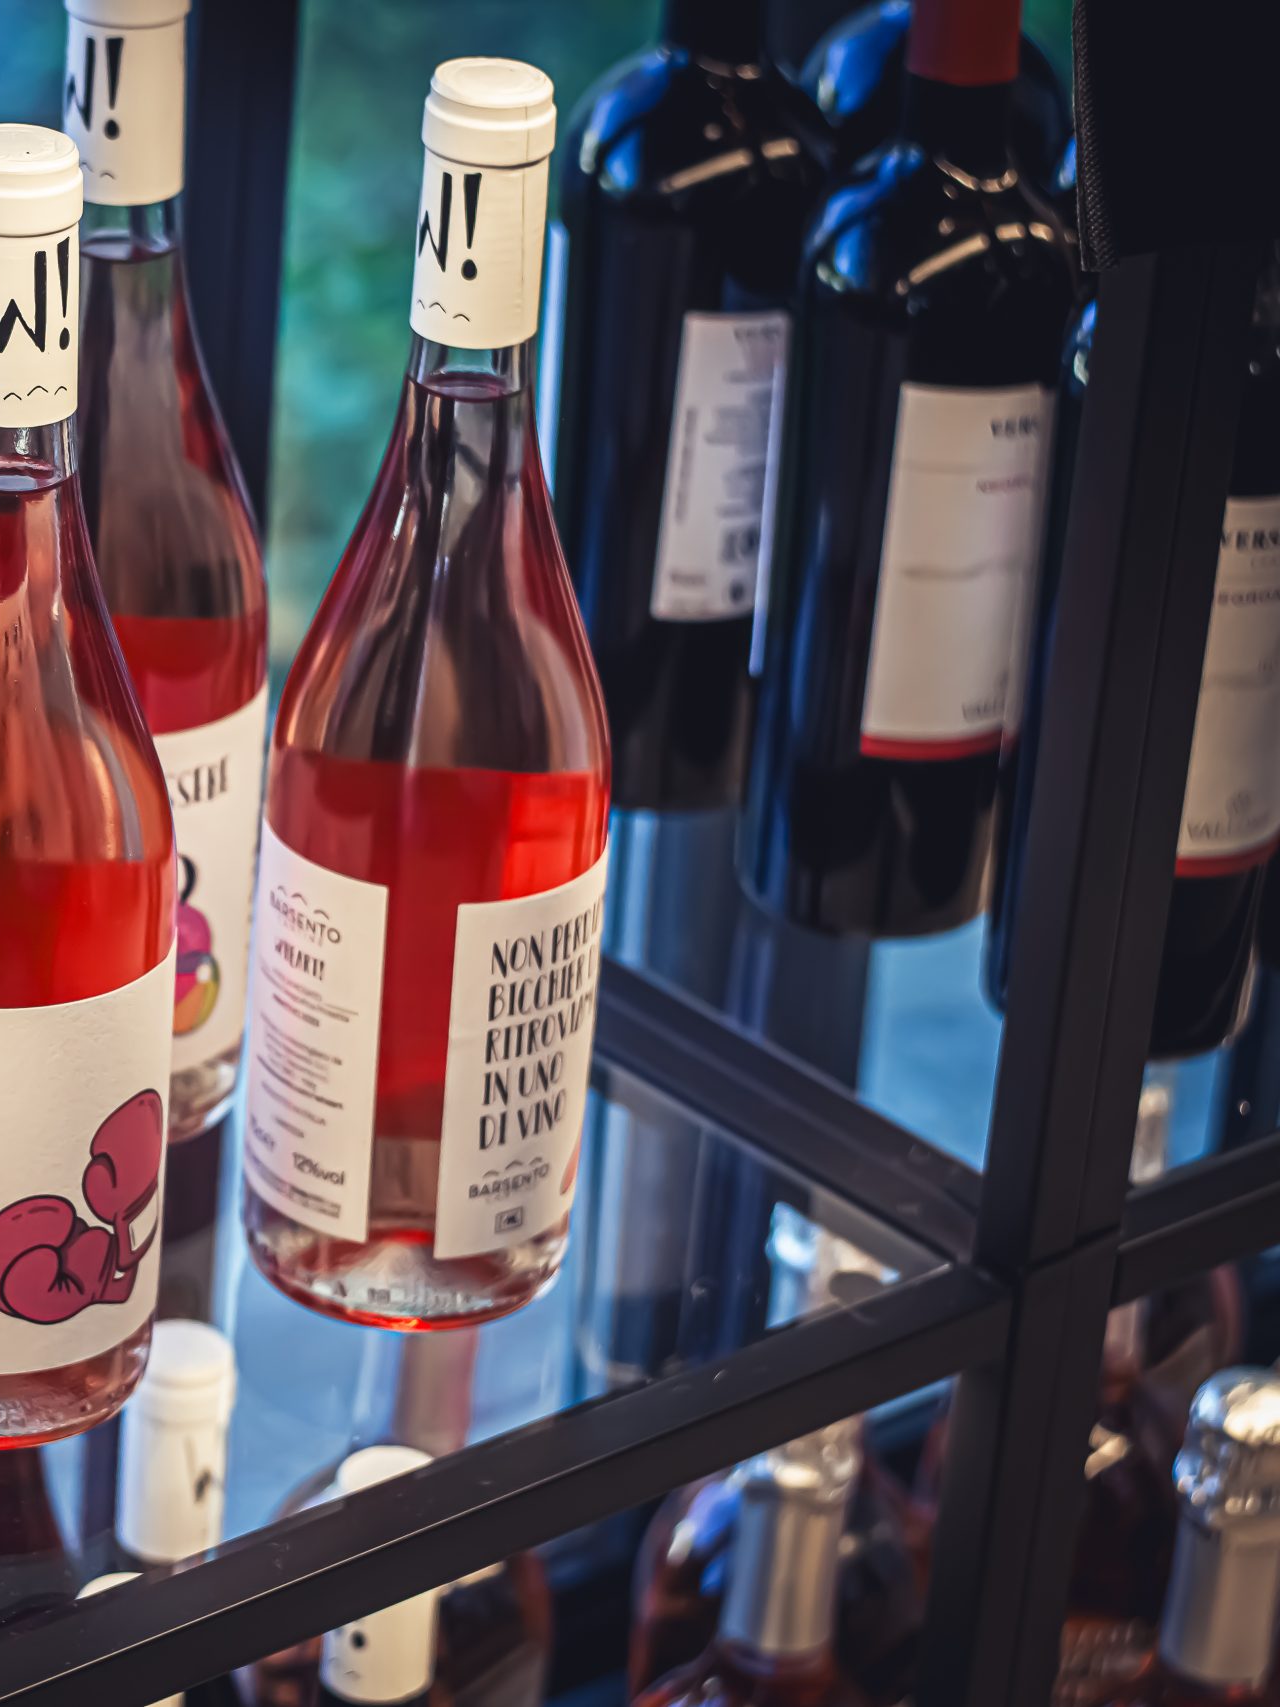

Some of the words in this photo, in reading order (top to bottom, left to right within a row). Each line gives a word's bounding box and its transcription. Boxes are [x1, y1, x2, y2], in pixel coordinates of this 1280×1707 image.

[491, 930, 544, 979] NON
[483, 1067, 509, 1107] IN
[519, 1051, 565, 1097] UNO
[480, 1111, 508, 1151] DI
[517, 1089, 567, 1141] VINO
